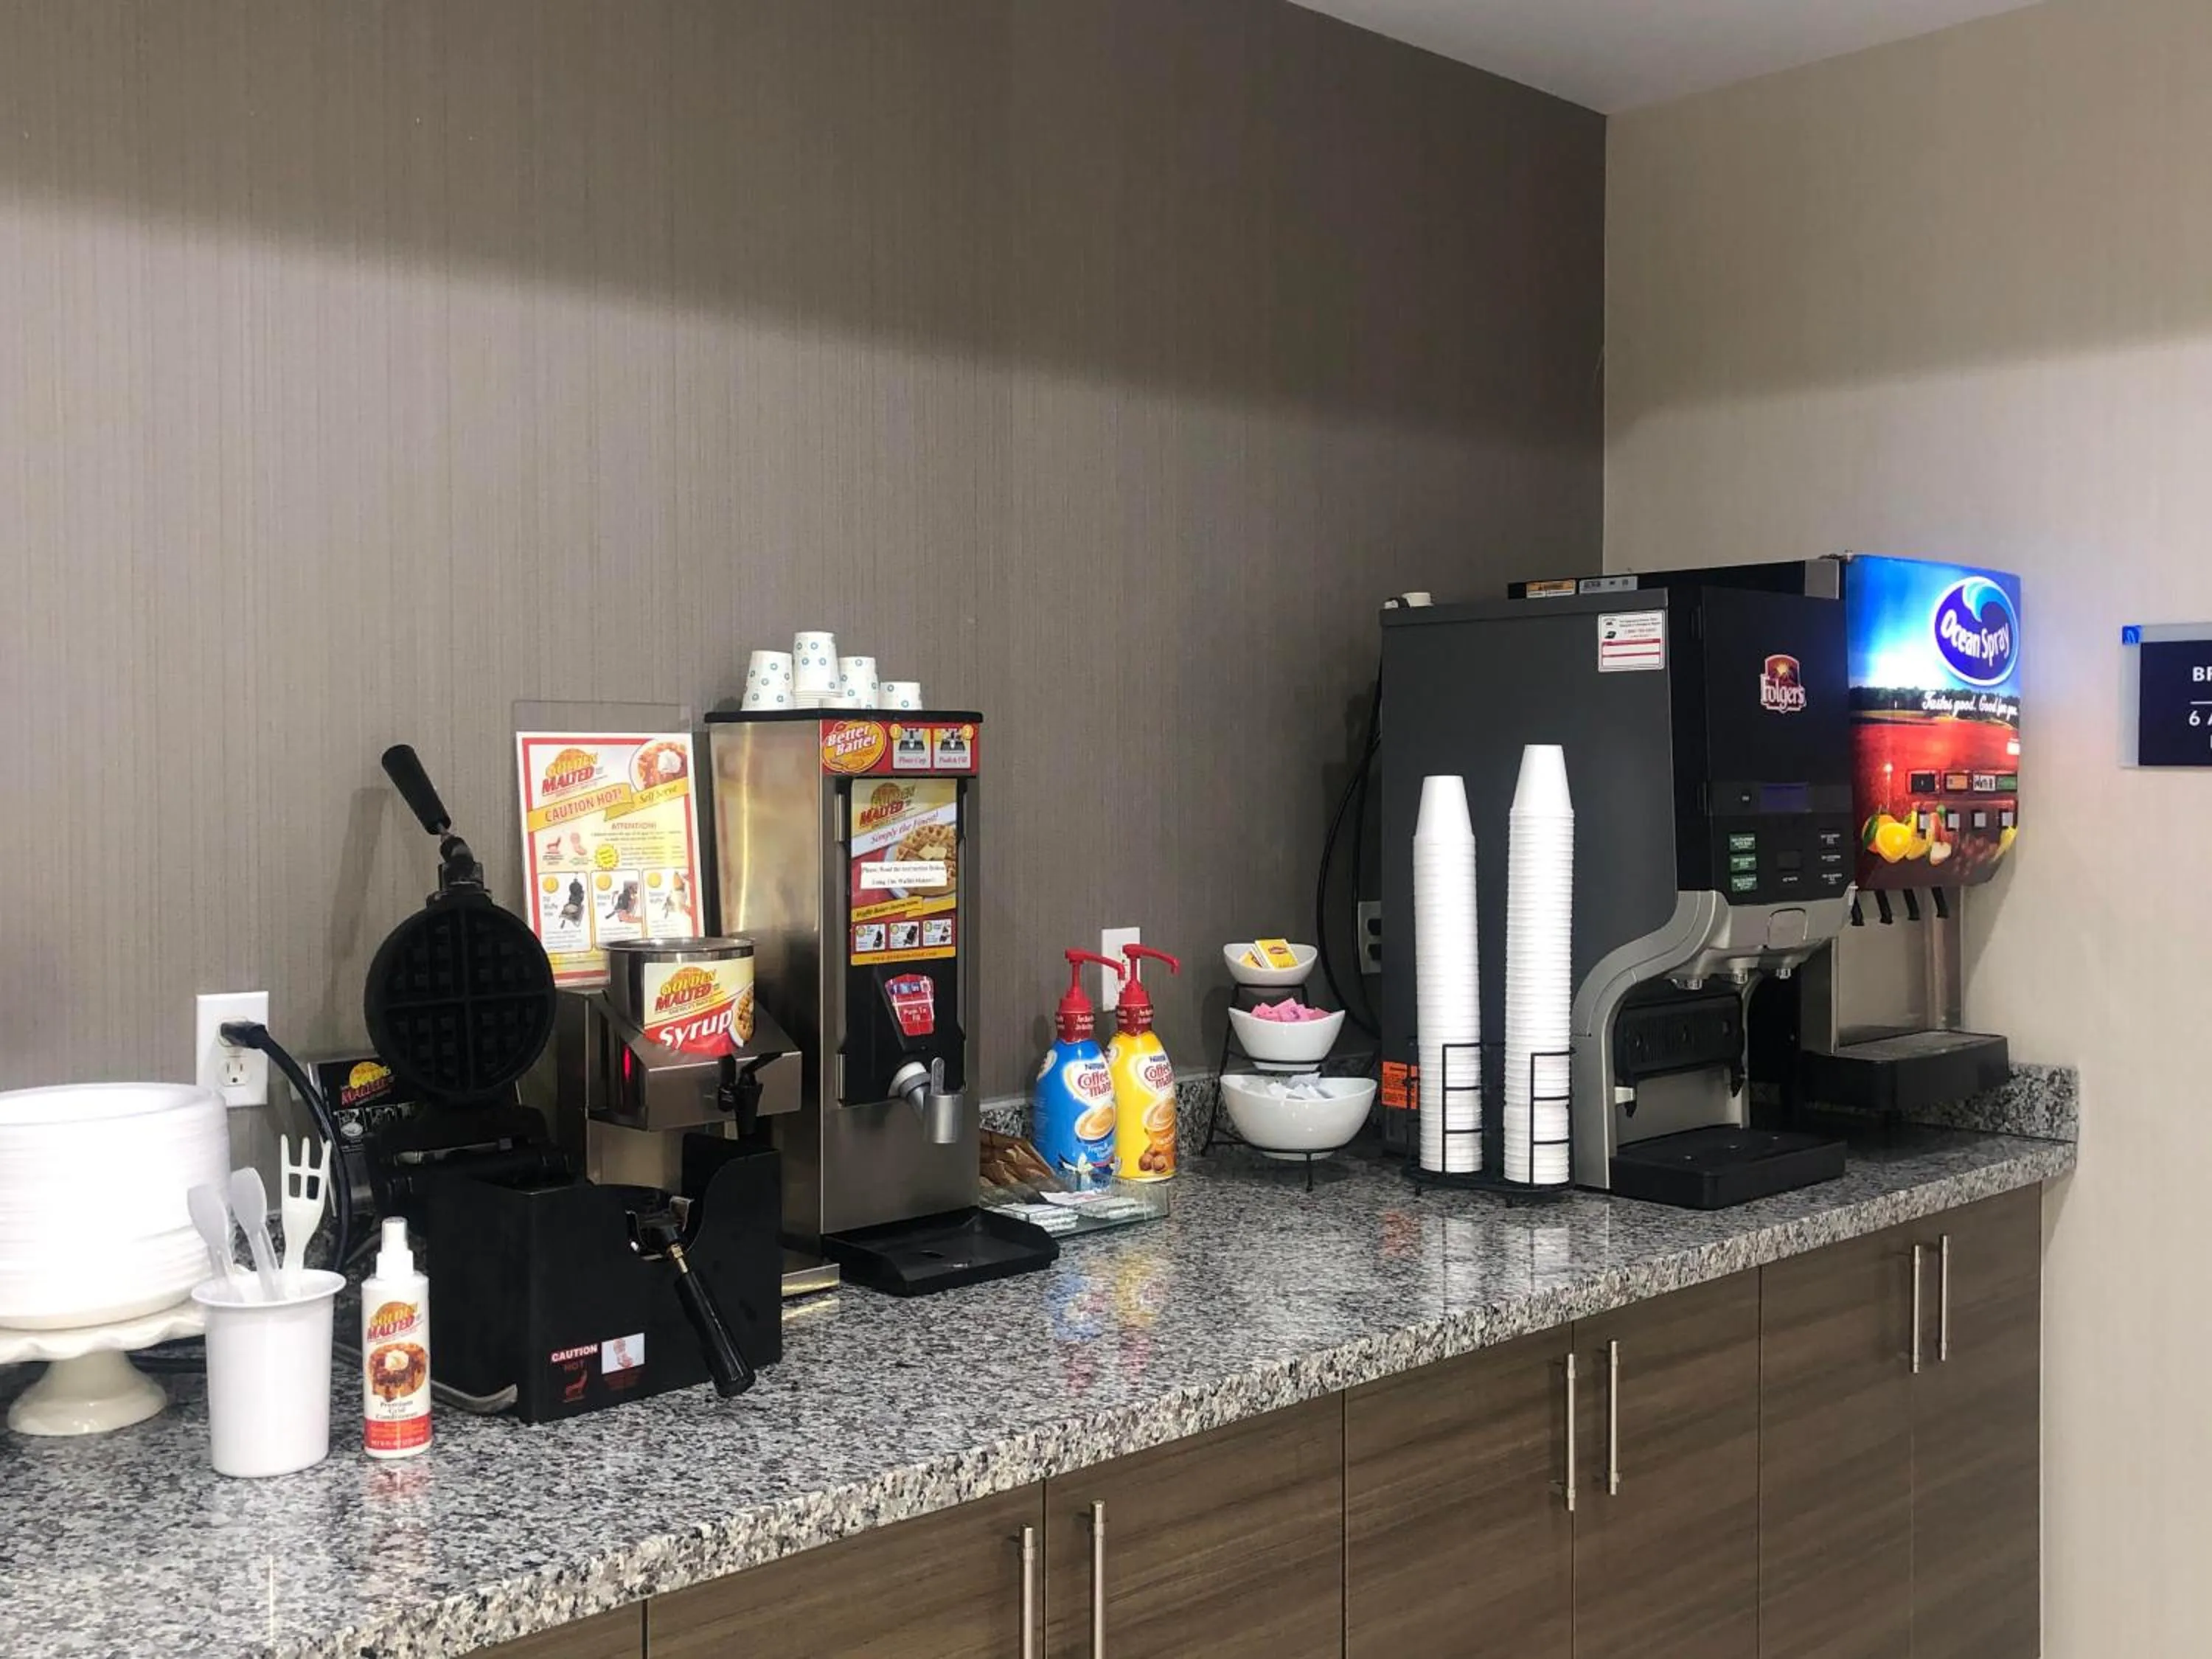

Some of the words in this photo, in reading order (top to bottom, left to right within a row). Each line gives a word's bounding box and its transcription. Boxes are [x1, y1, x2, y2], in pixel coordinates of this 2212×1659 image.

[1941, 609, 1980, 658] Ocean
[1980, 623, 2010, 667] Spray
[1761, 674, 1805, 709] Folgers
[1921, 691, 1953, 711] Tastes
[1954, 695, 1977, 717] good.
[1979, 695, 1997, 712] Good
[2188, 710, 2201, 727] 6
[827, 725, 870, 747] Better
[836, 735, 877, 756] Batter
[542, 765, 595, 795] MALTED
[545, 797, 594, 822] CAUTION
[597, 788, 622, 806] HOT!
[859, 800, 904, 827] MALTED
[660, 969, 717, 996] GOLDEN
[655, 983, 712, 1012] MALTED
[659, 1009, 733, 1050] Syrup
[367, 1315, 415, 1340] MALTED
[552, 1343, 598, 1363] CAUTION
